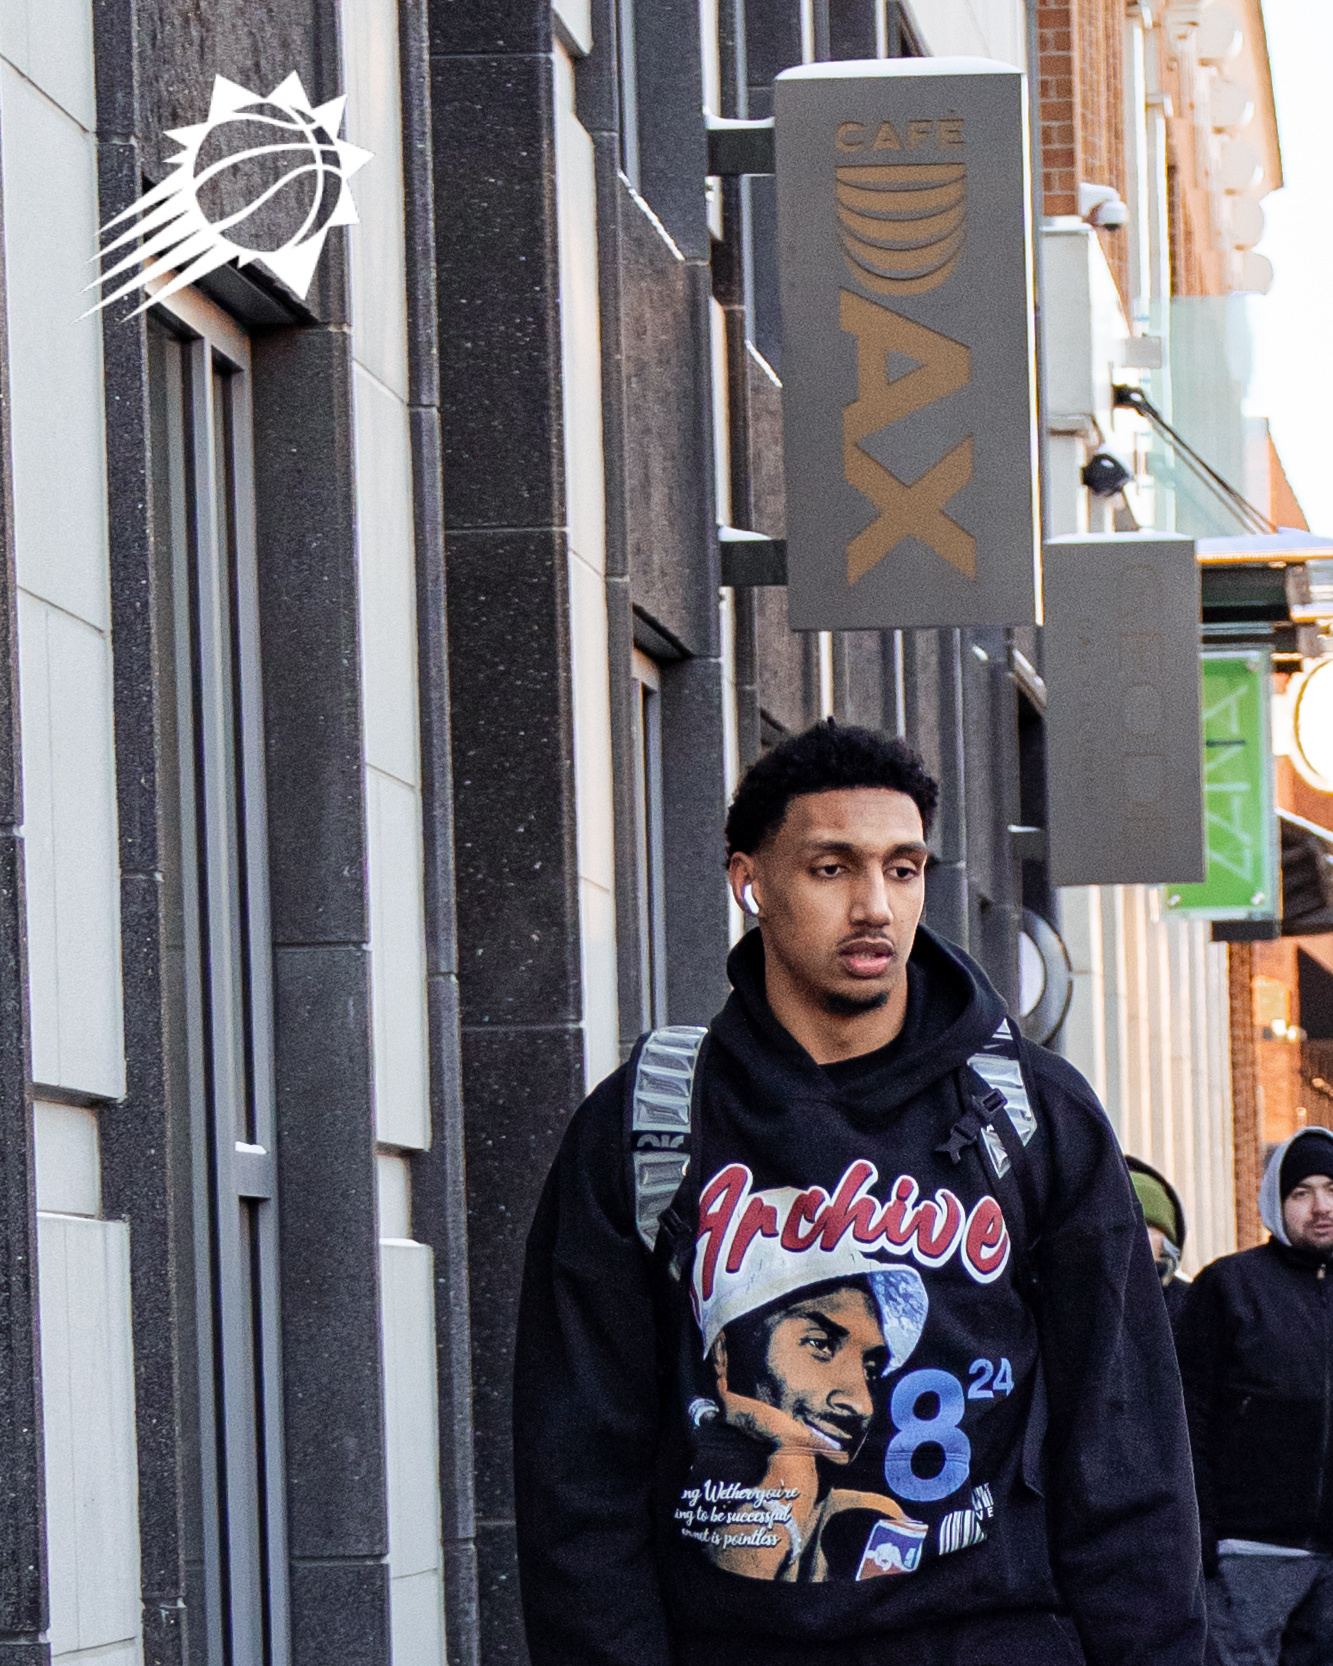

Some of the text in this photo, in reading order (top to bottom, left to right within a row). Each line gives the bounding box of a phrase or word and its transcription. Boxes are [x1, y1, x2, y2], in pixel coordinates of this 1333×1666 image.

[835, 162, 977, 586] DAX
[694, 1159, 1011, 1302] Archive
[968, 1357, 1015, 1399] 24
[885, 1368, 971, 1503] 8
[696, 1505, 709, 1522] to
[710, 1506, 726, 1522] be
[722, 1526, 780, 1549] pointless
